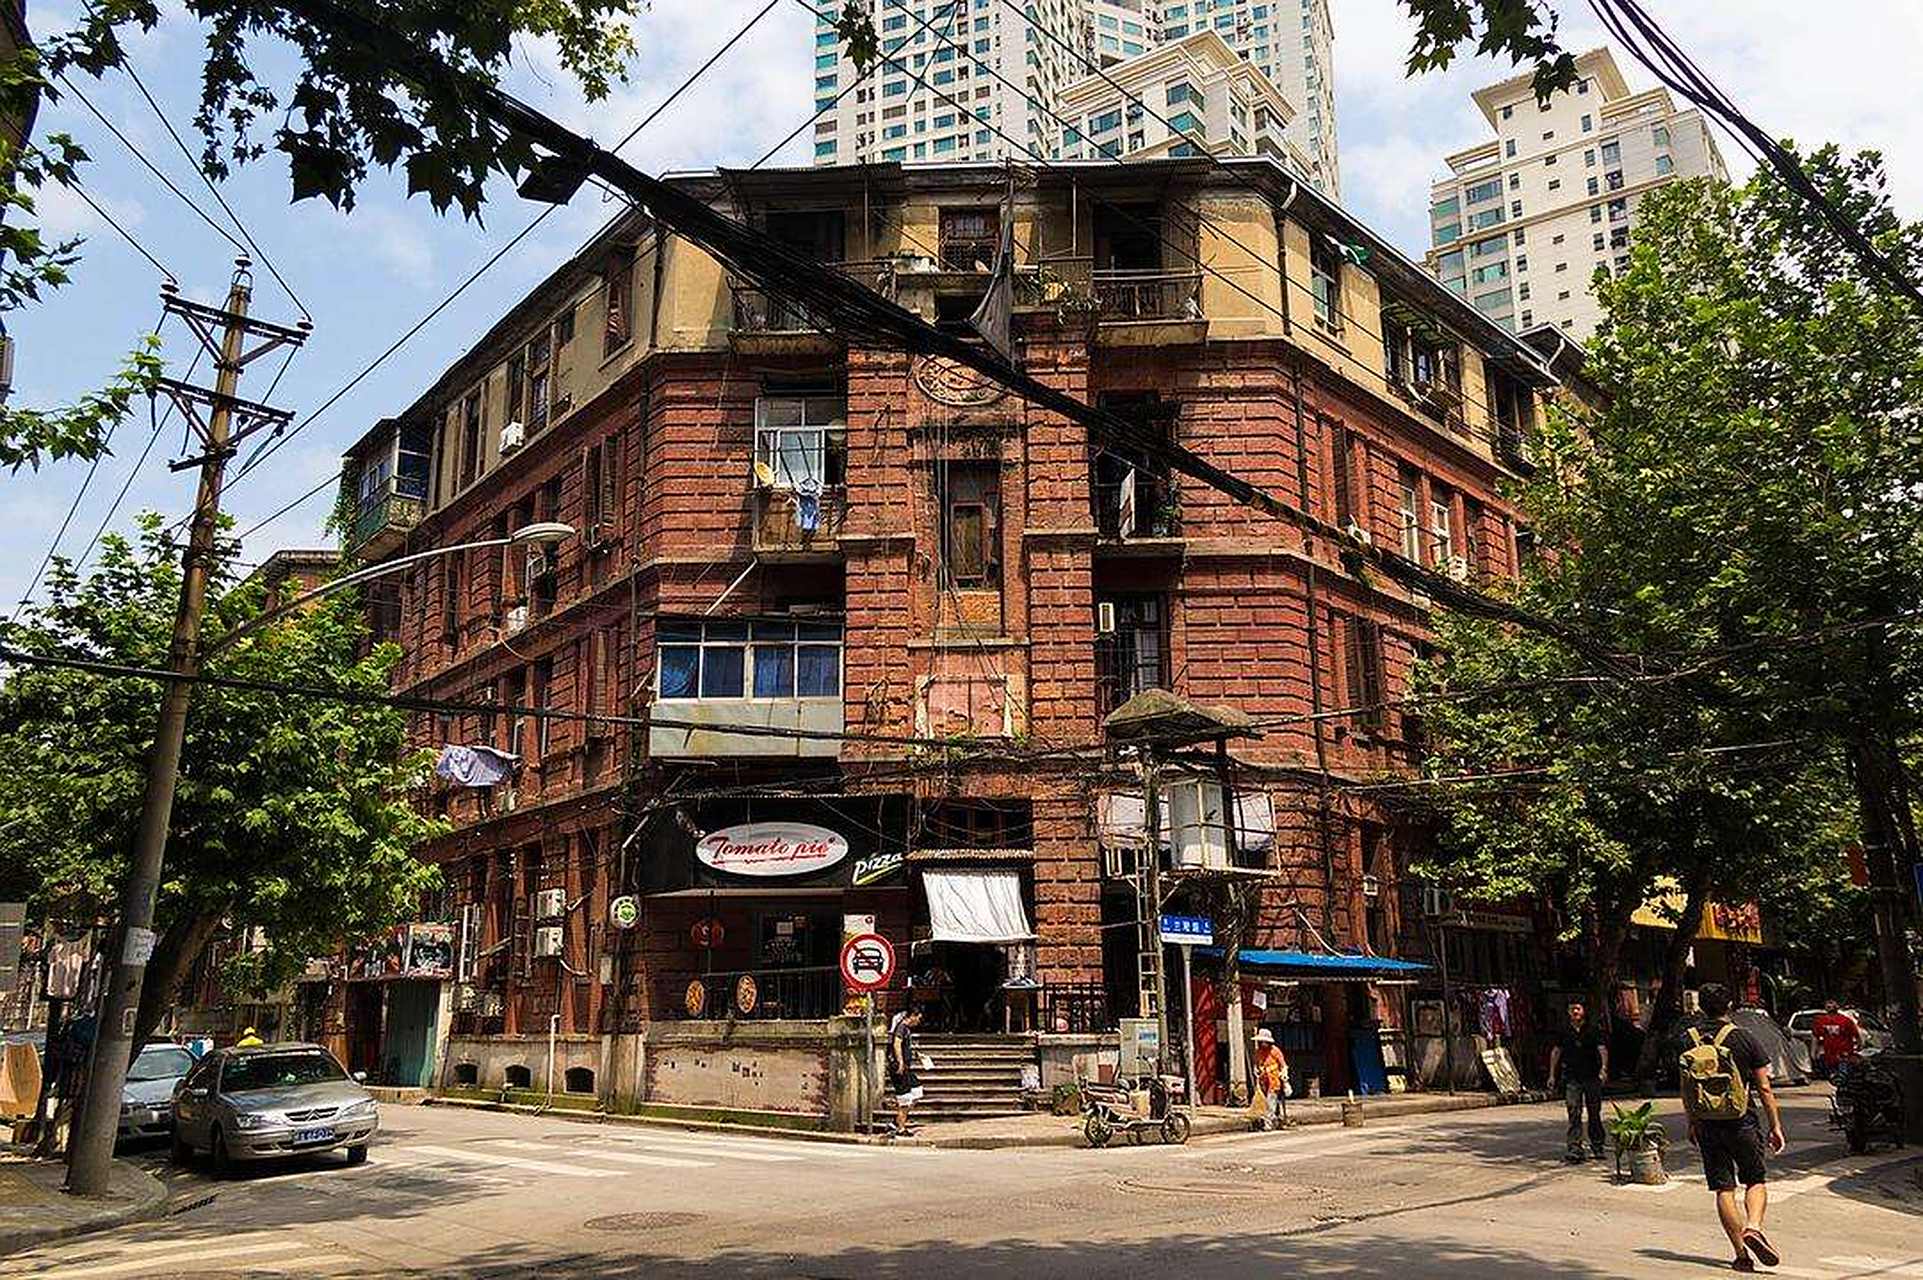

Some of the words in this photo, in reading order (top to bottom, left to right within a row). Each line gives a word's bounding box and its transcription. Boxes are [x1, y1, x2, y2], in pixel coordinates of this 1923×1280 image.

[707, 836, 788, 859] Tomato
[790, 839, 829, 861] pie
[852, 852, 905, 884] pizza
